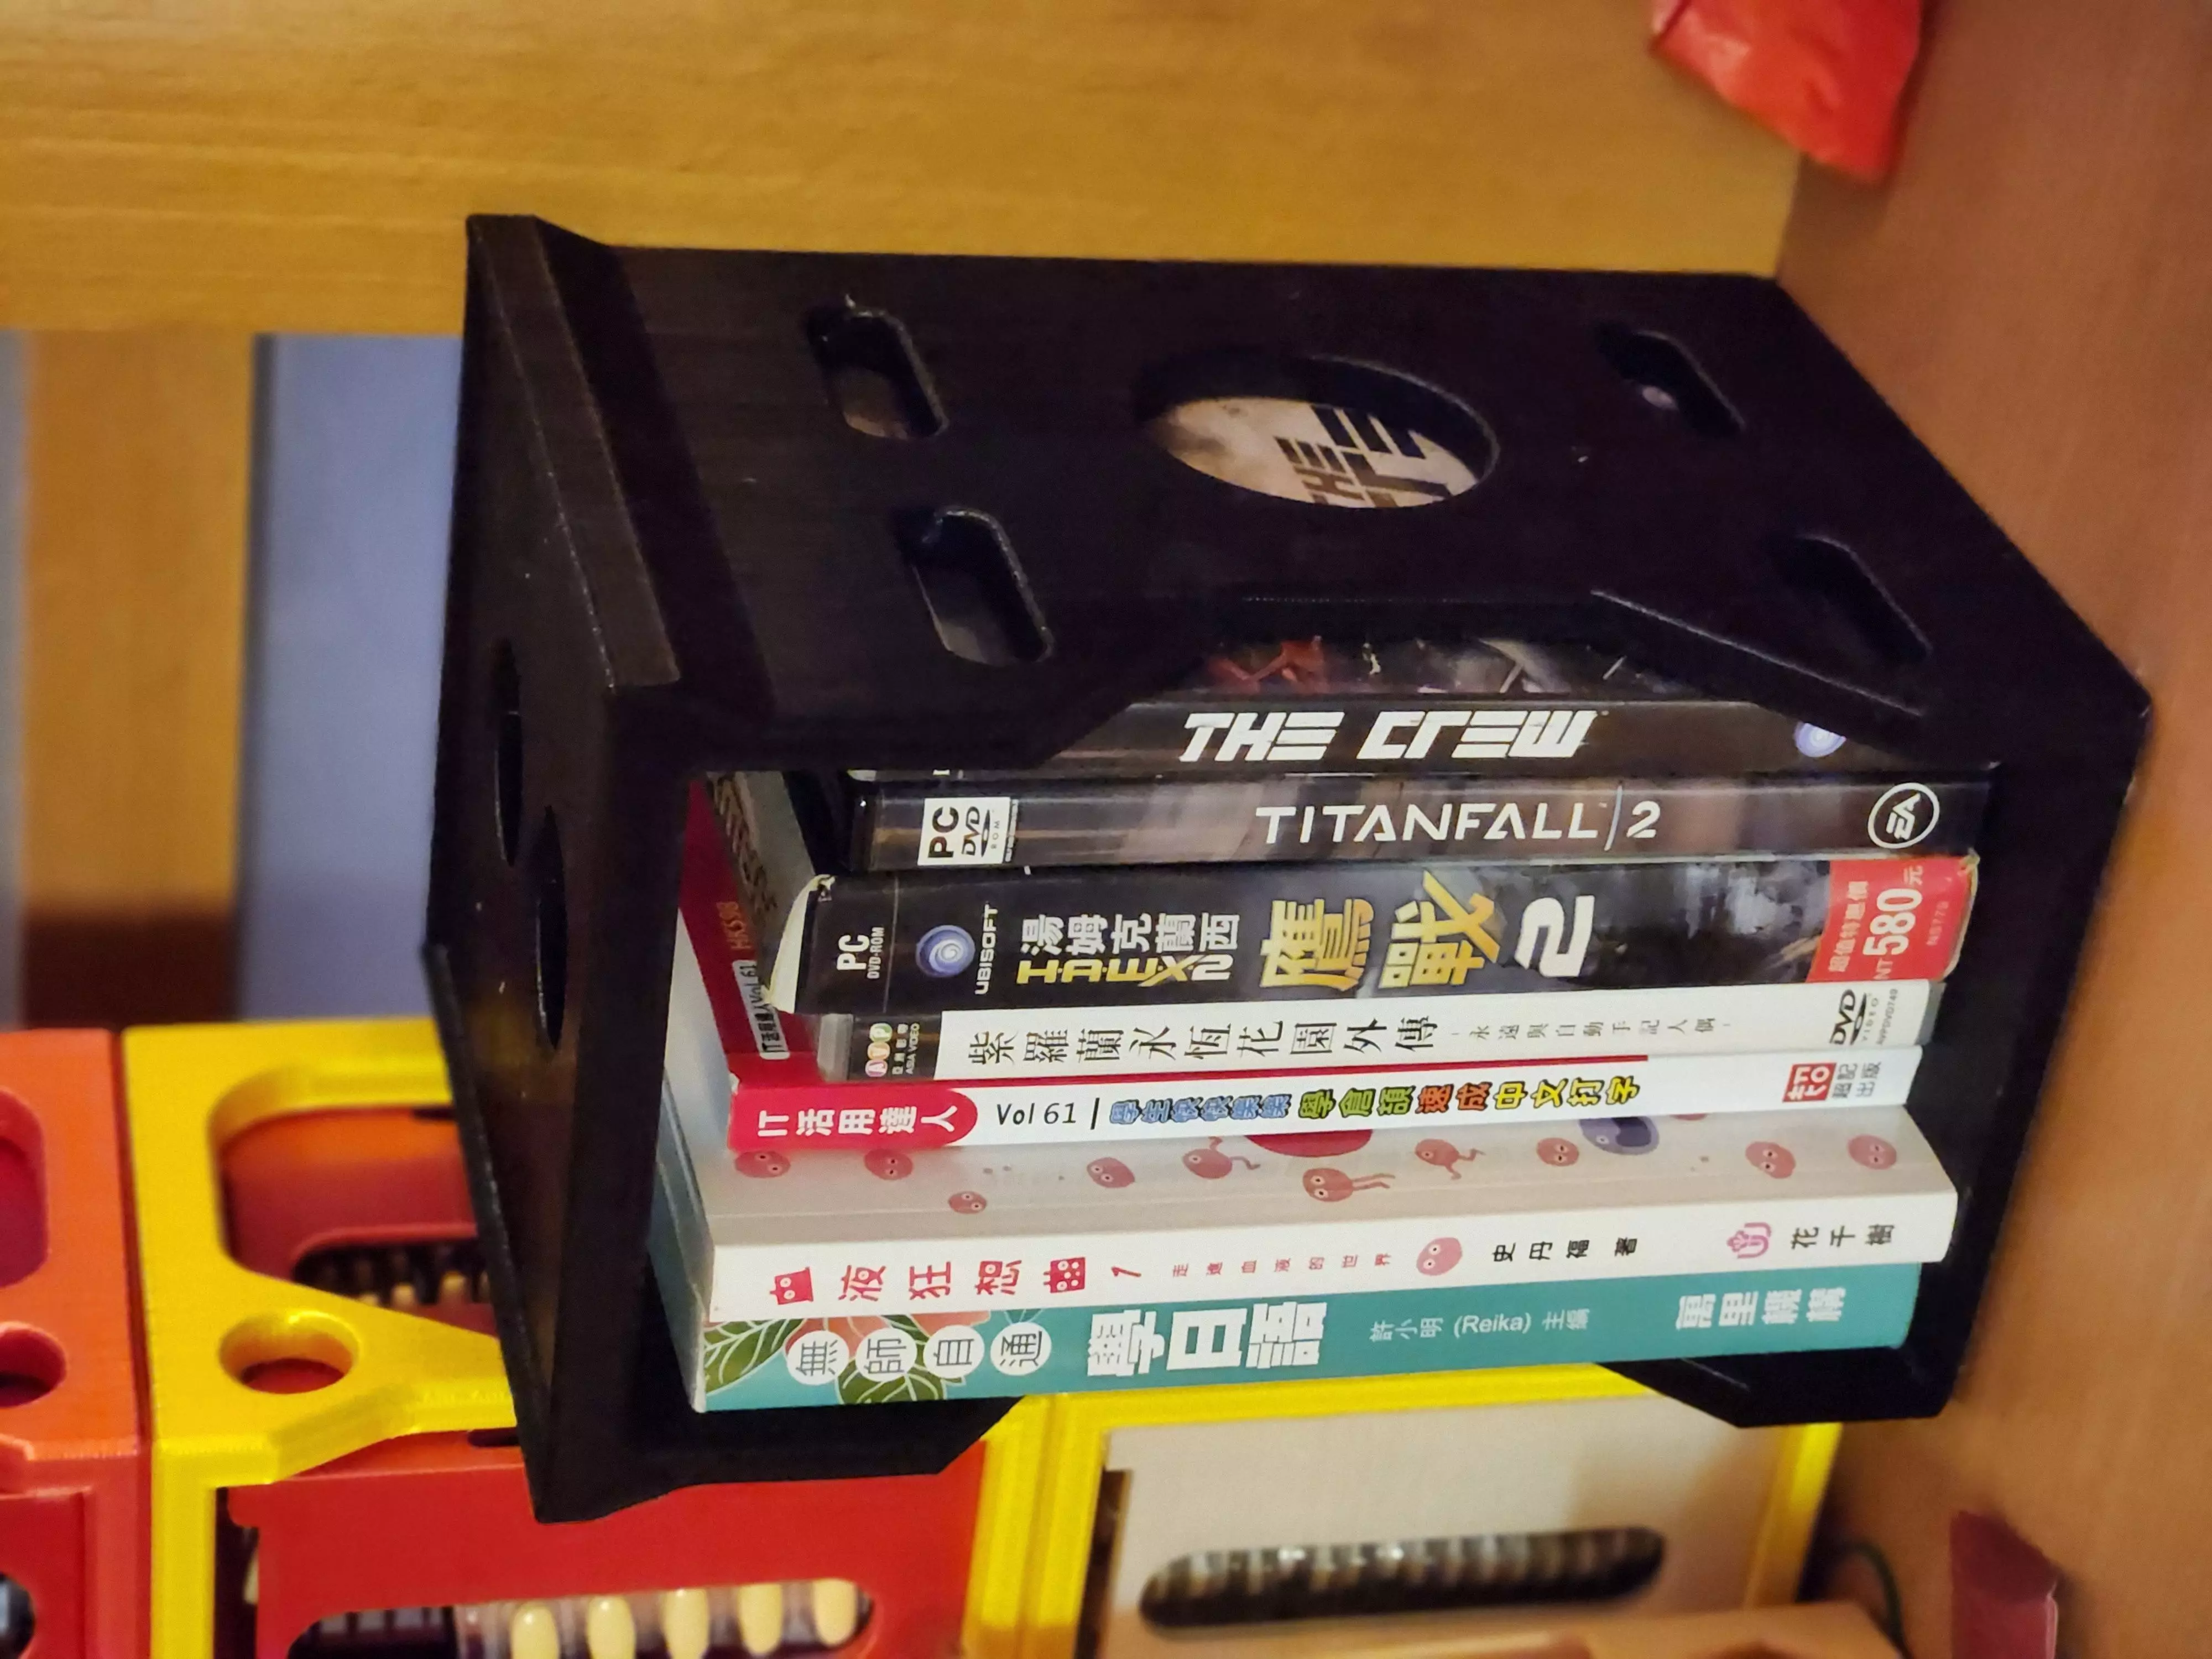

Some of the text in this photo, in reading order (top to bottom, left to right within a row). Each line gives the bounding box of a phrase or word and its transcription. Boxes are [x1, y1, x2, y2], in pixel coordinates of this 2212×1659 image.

[1179, 710, 1598, 762] THE CREW
[927, 805, 960, 859] PC
[960, 805, 982, 857] DVD
[990, 818, 1001, 852] ROM
[1255, 800, 1661, 844] TITANFALL 2
[1886, 792, 1922, 840] EA
[1020, 911, 1240, 956] 湯姆克蘭西
[1862, 888, 1923, 956] 580
[1903, 865, 1924, 885] 元
[837, 934, 870, 973] PC
[866, 926, 885, 980] DVD-ROM
[975, 904, 998, 996] UBISOFT
[968, 1015, 1438, 1066] 紫羅蘭永恆花園外傳
[1829, 989, 1855, 1045] DVD
[1861, 997, 1879, 1041] VIDEO
[866, 1023, 891, 1076] AVP
[1855, 1061, 1882, 1098] 出版
[758, 1104, 958, 1137] IT活用達人
[997, 1103, 1034, 1126] Vol
[1044, 1102, 1076, 1125] 61
[1172, 1253, 1392, 1277] 走進血液的世界
[1491, 1239, 1590, 1263] 史丹福
[1614, 1237, 1638, 1258] 著
[1791, 1223, 1895, 1251] 花千樹
[795, 1287, 1846, 1378] 無師自通 學日語 許小明 (Reika) 主編 萬里機構
